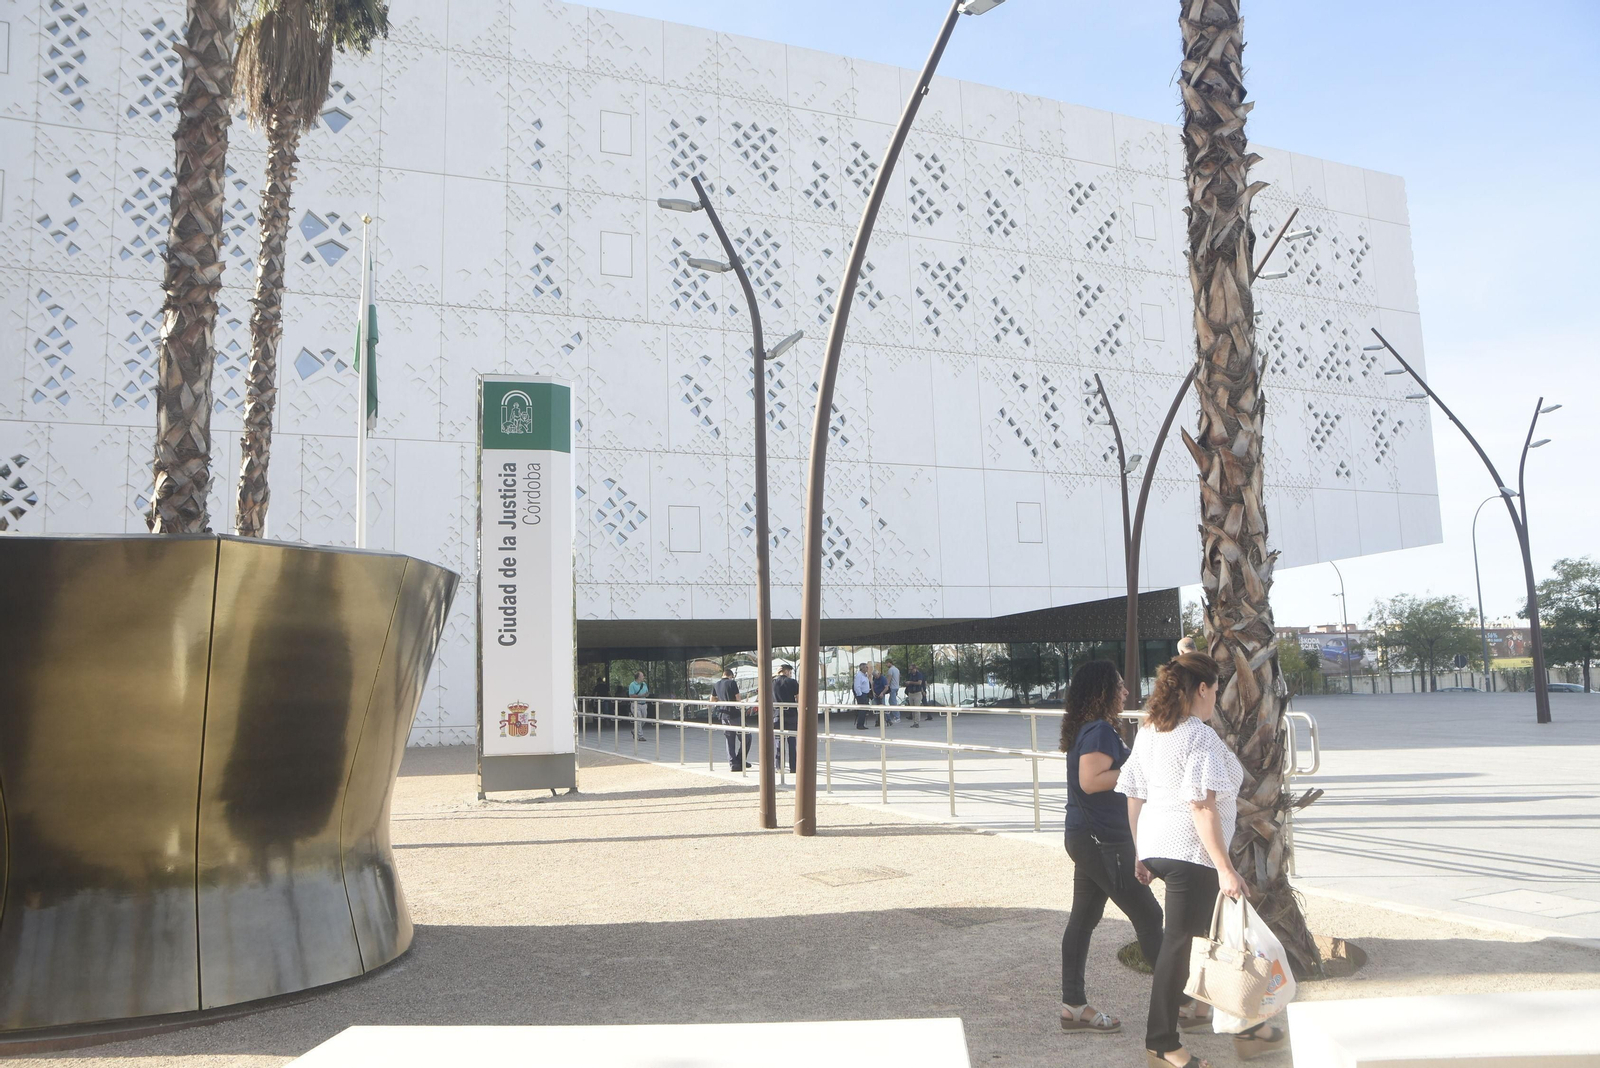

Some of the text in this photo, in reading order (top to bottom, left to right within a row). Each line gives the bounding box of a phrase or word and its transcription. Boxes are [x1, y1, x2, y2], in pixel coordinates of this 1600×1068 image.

[498, 462, 517, 646] Ciudad de la Justicia
[522, 463, 541, 525] Córdoba
